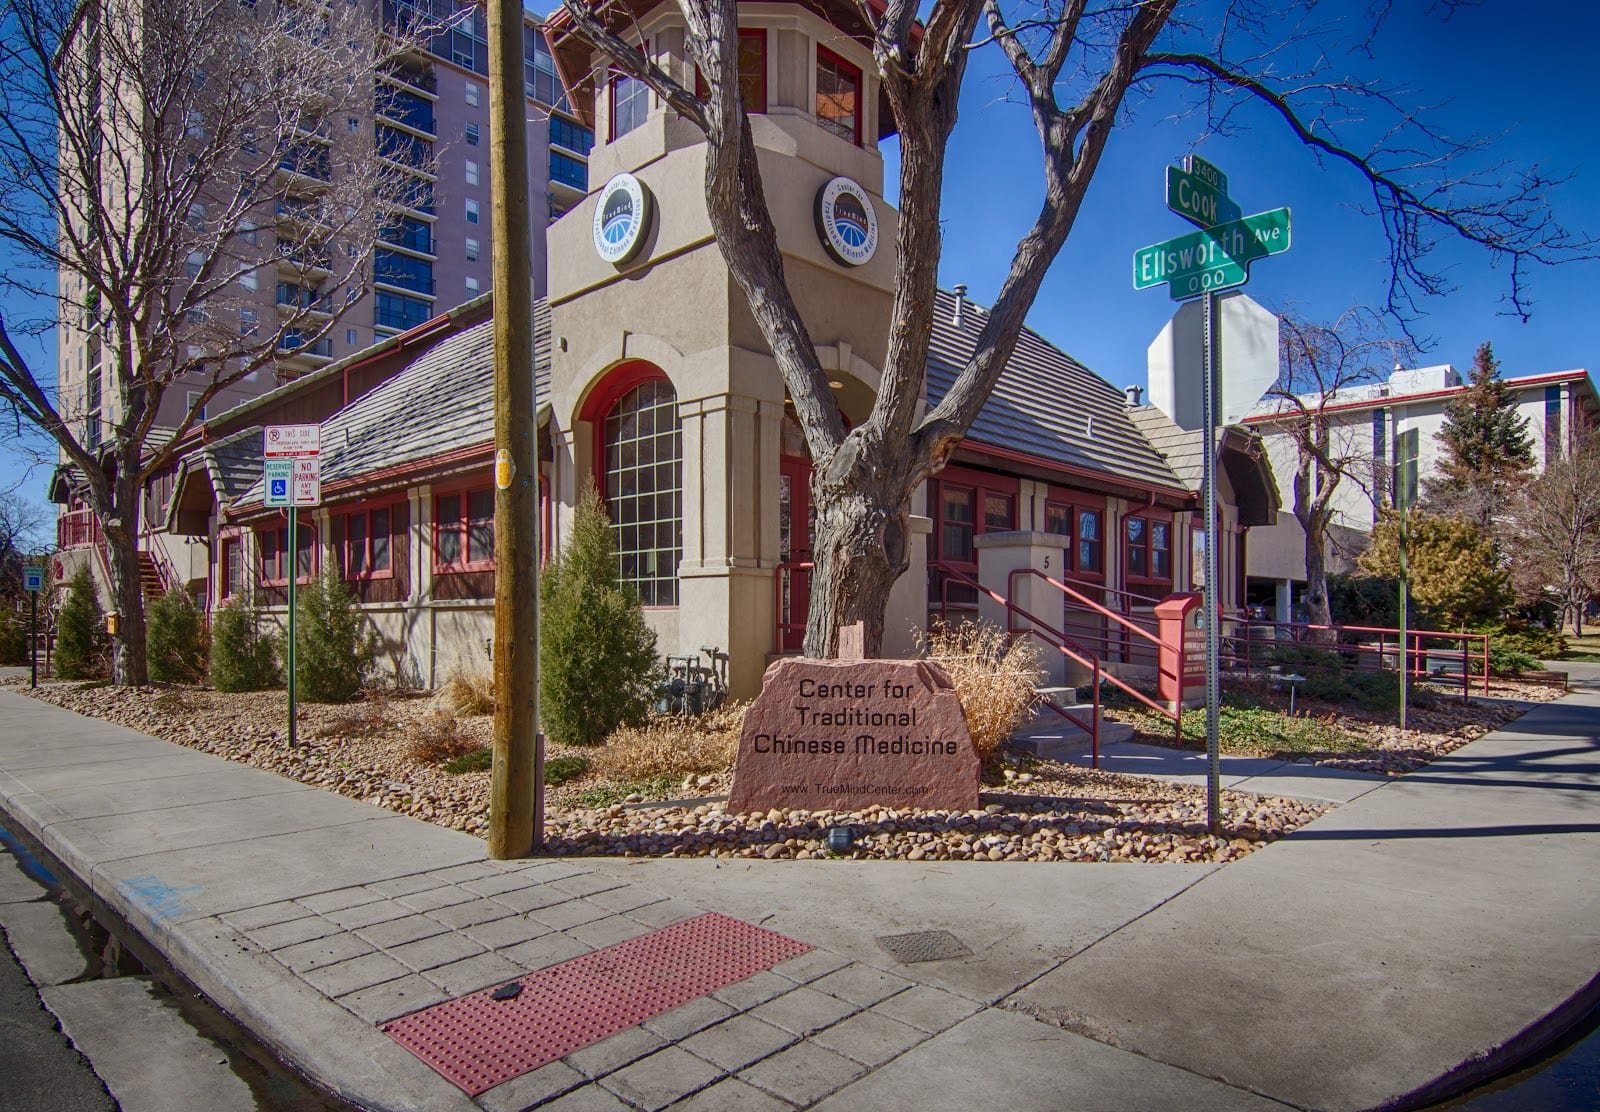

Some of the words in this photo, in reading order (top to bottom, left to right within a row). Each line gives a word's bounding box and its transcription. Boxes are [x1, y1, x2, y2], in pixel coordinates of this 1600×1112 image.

[1178, 178, 1217, 223] Cook
[825, 200, 842, 247] Traditional
[842, 245, 865, 259] Chinese
[863, 222, 877, 255] Medicine
[1141, 228, 1244, 282] Ellsworth
[1253, 226, 1280, 244] Ave
[294, 472, 318, 482] PARKING
[301, 463, 311, 471] NO
[1044, 555, 1050, 569] 5
[799, 678, 874, 699] Center
[883, 679, 914, 699] for
[795, 706, 917, 727] Traditional
[754, 733, 846, 755] Chinese
[855, 734, 958, 756] Medicine
